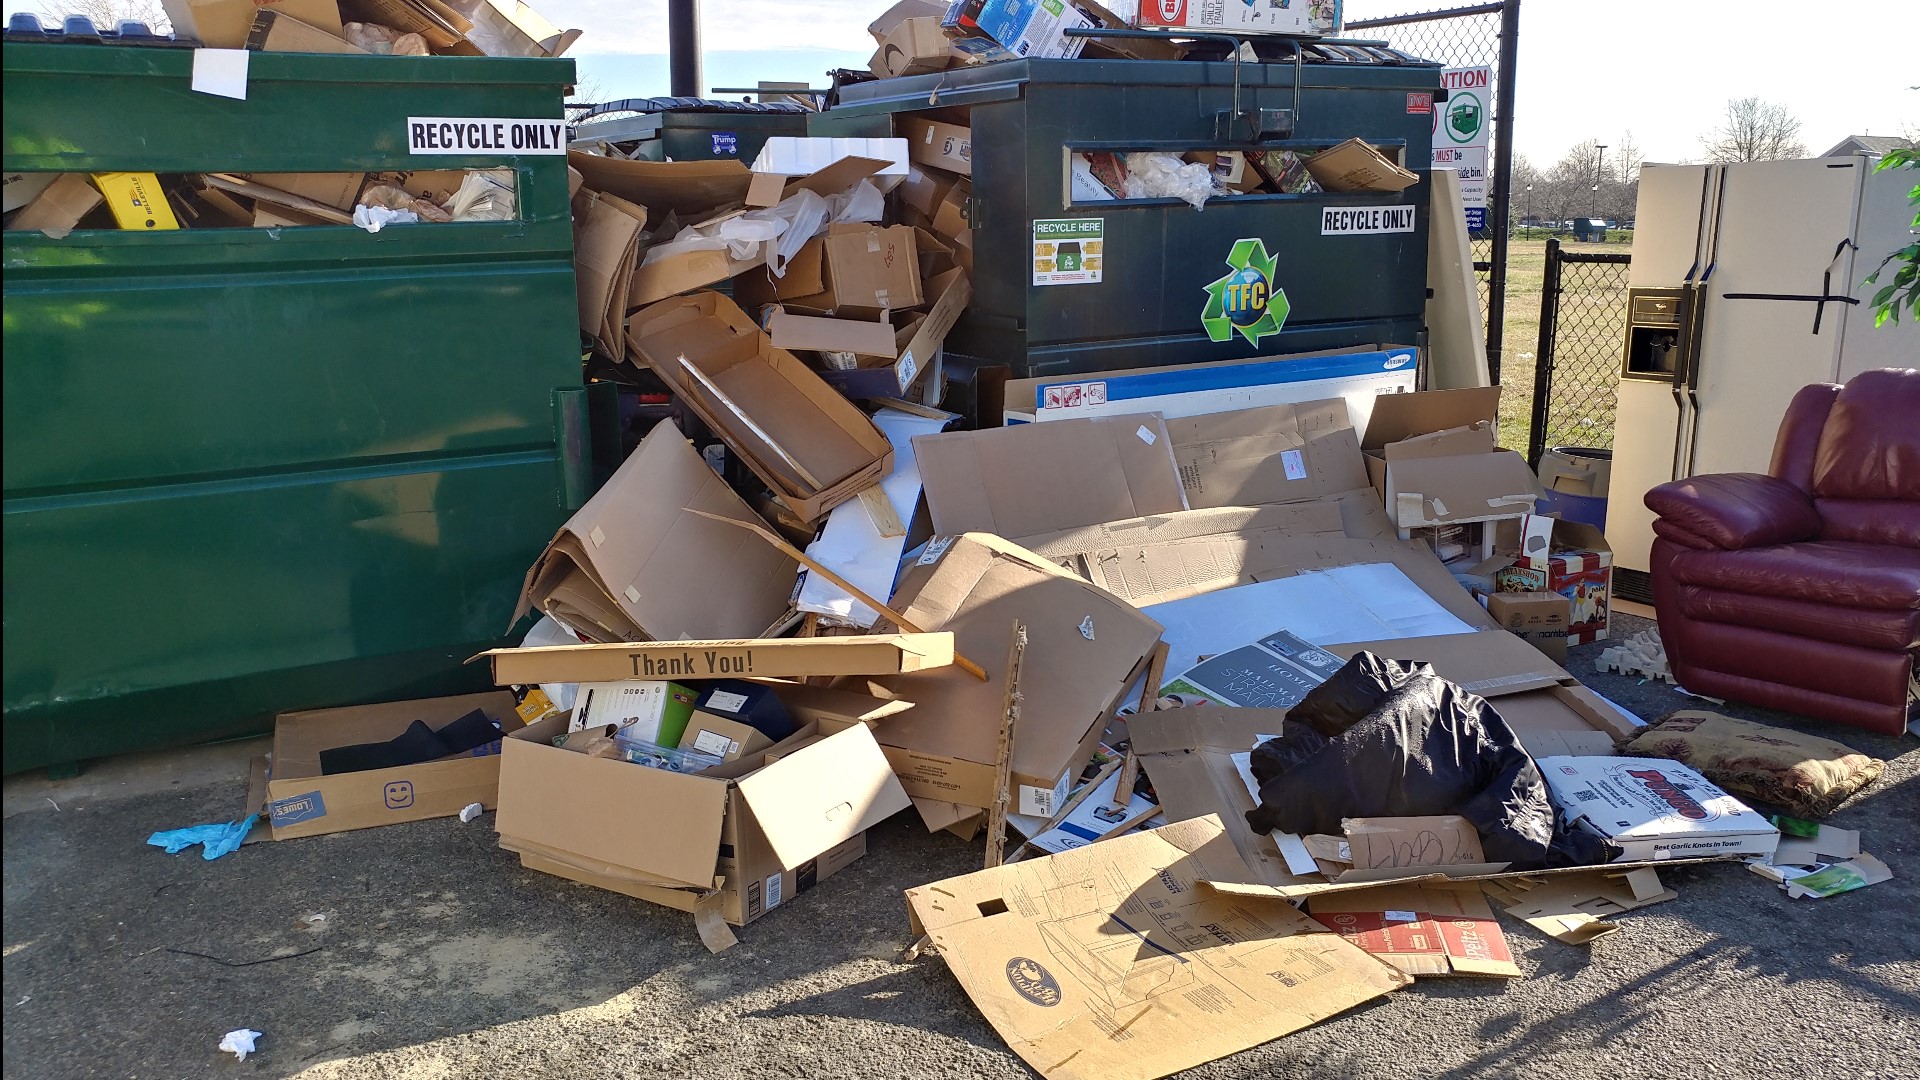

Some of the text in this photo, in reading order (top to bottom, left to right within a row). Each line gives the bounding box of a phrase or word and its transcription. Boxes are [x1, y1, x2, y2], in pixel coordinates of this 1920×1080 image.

[1206, 2, 1214, 25] CHILD
[1213, 0, 1223, 25] TRAILE
[1440, 70, 1487, 88] NTION
[412, 123, 561, 149] RECYCLE ONLY
[711, 134, 737, 145] Trump
[1435, 150, 1463, 161] MUST be
[1074, 172, 1099, 198] Beauty
[1457, 167, 1483, 179] side bin.
[131, 177, 153, 215] BELLEVILLE
[1037, 222, 1101, 233] RECYCLE HERE
[1324, 209, 1413, 231] RECYCLE ONLY
[1228, 281, 1266, 312] TFC
[629, 650, 753, 676] Thank You!
[1268, 664, 1316, 692] HOME
[1626, 769, 1708, 819] PUNGO
[1162, 877, 1177, 894] LISTA
[1010, 966, 1057, 1006] HAMPTON
